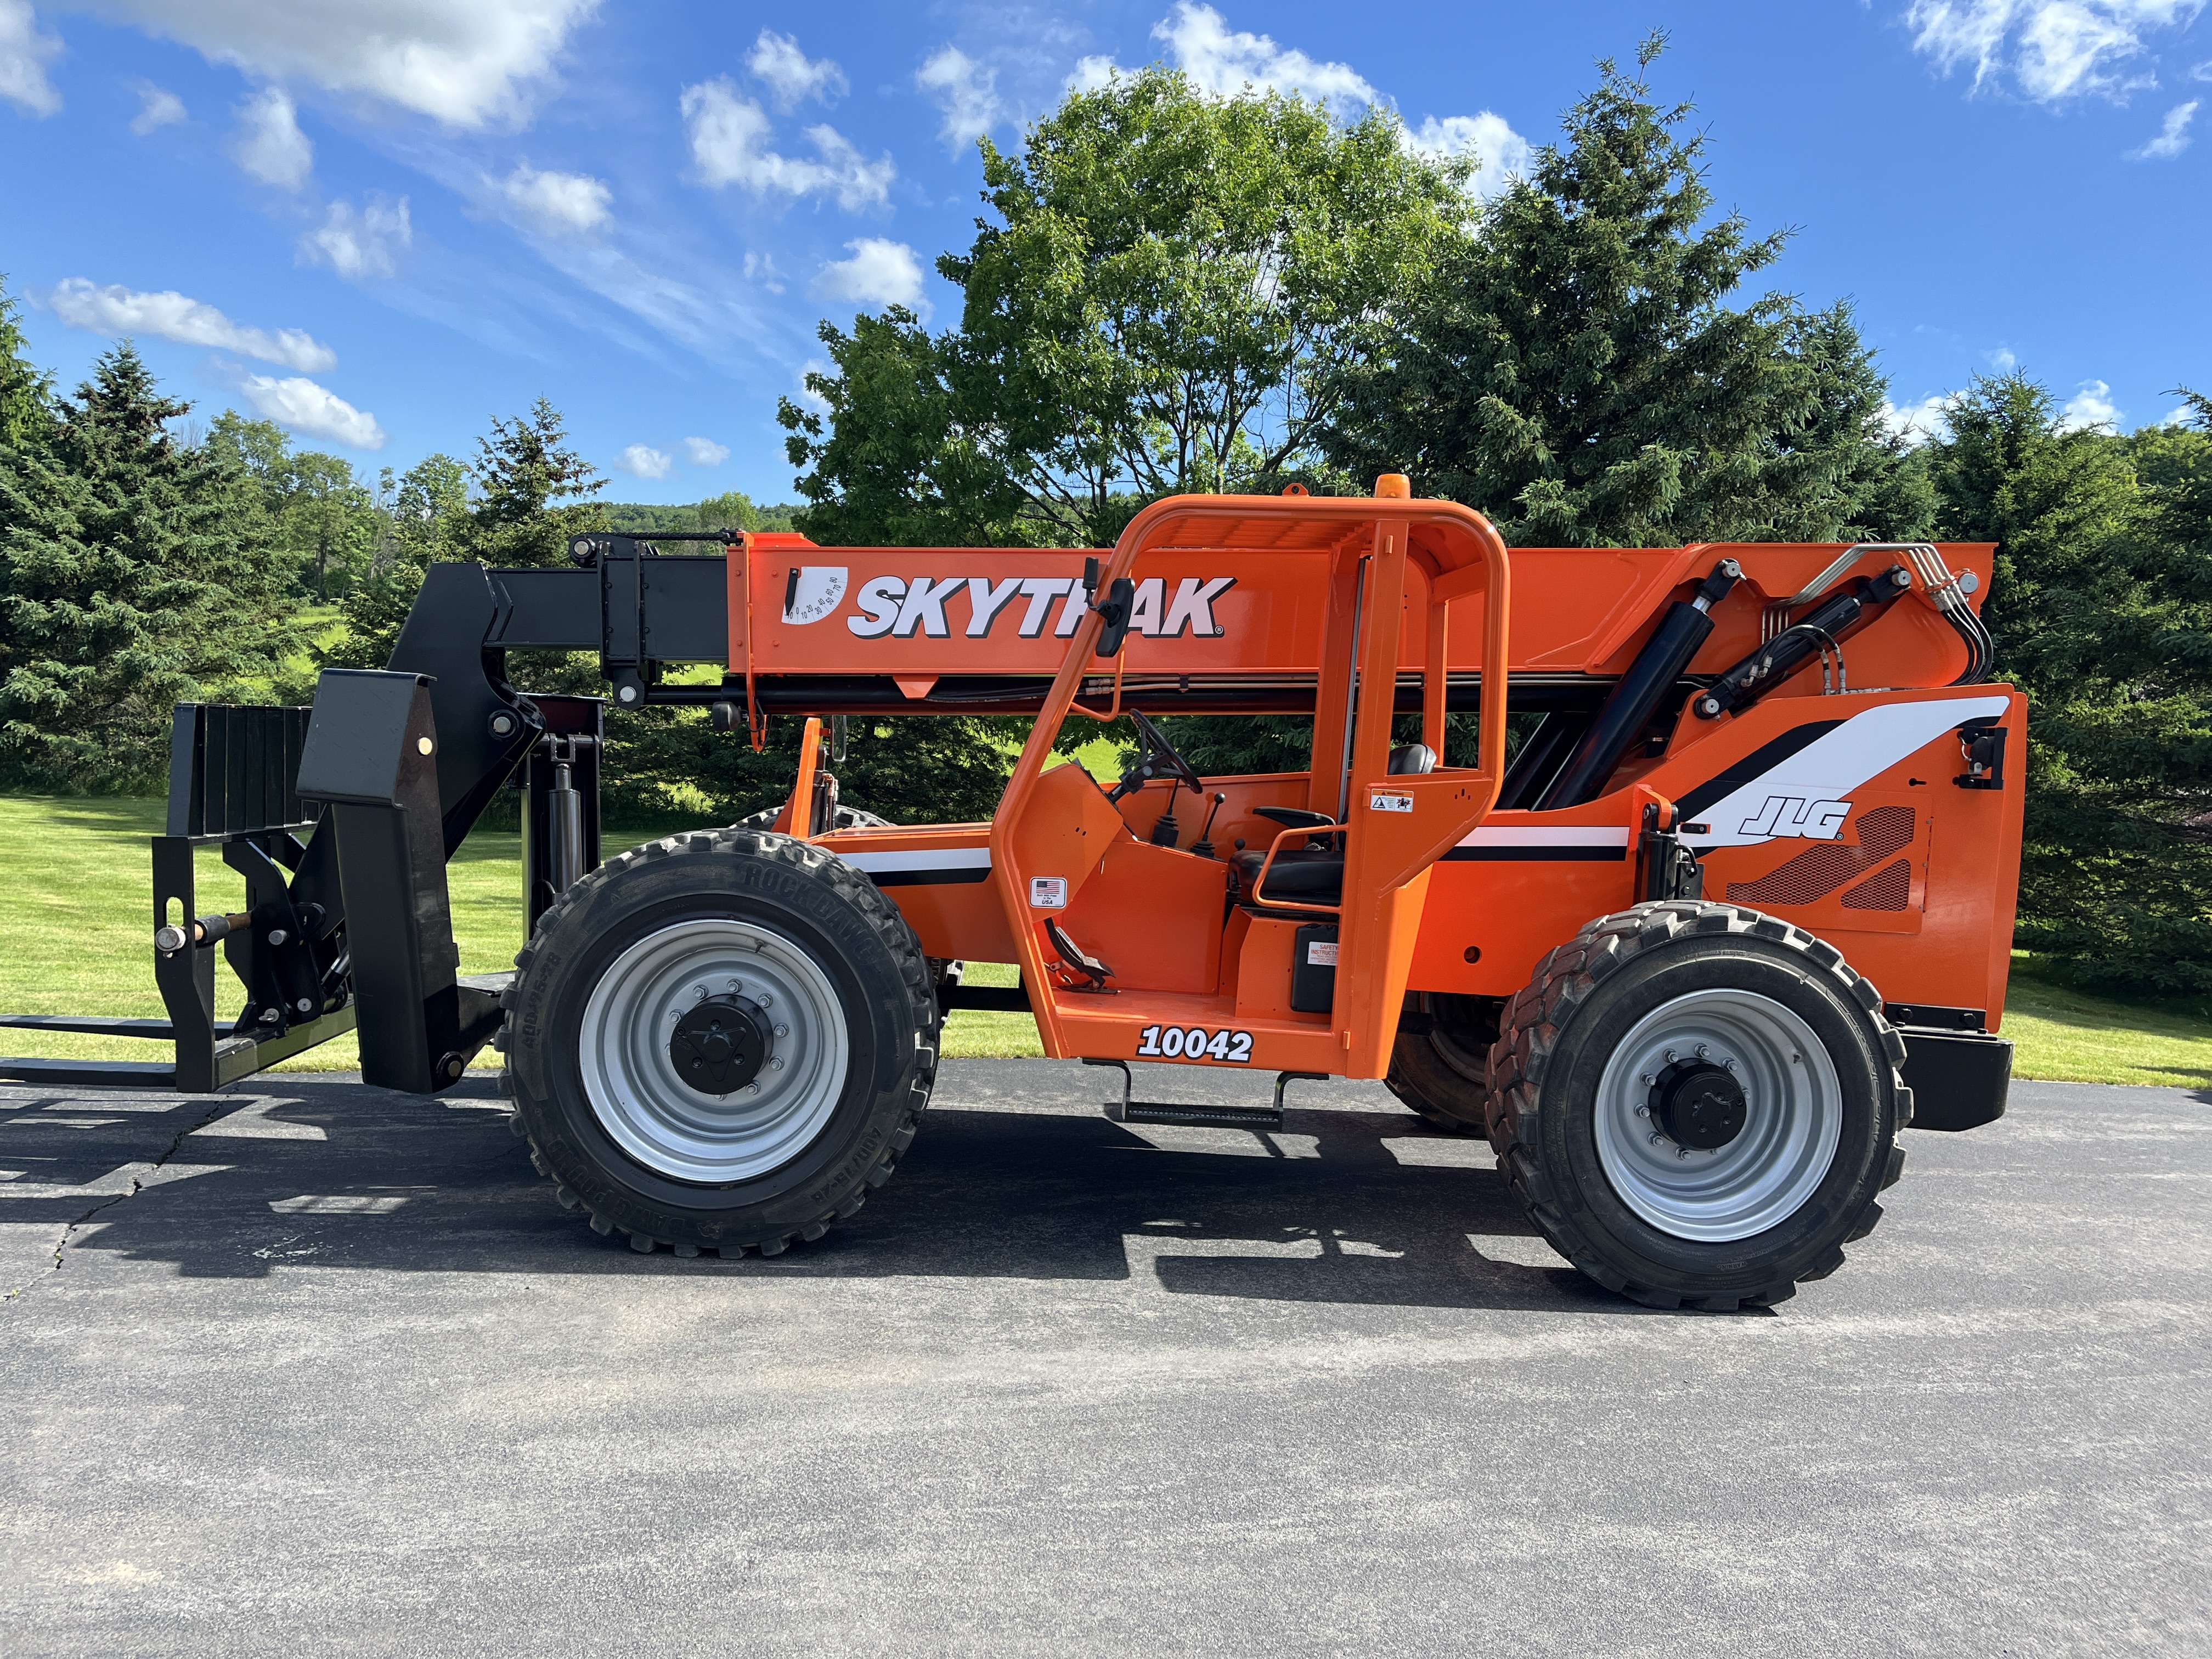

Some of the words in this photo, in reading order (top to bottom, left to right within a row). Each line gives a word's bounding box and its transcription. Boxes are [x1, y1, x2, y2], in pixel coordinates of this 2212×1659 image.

[825, 588, 834, 596] 60
[817, 598, 826, 606] 40
[825, 597, 834, 605] 50
[806, 604, 813, 613] 20
[814, 606, 822, 615] 30
[1737, 795, 1854, 841] JLG
[1136, 1025, 1254, 1063] 10042
[810, 1126, 883, 1207] 400/75-28
